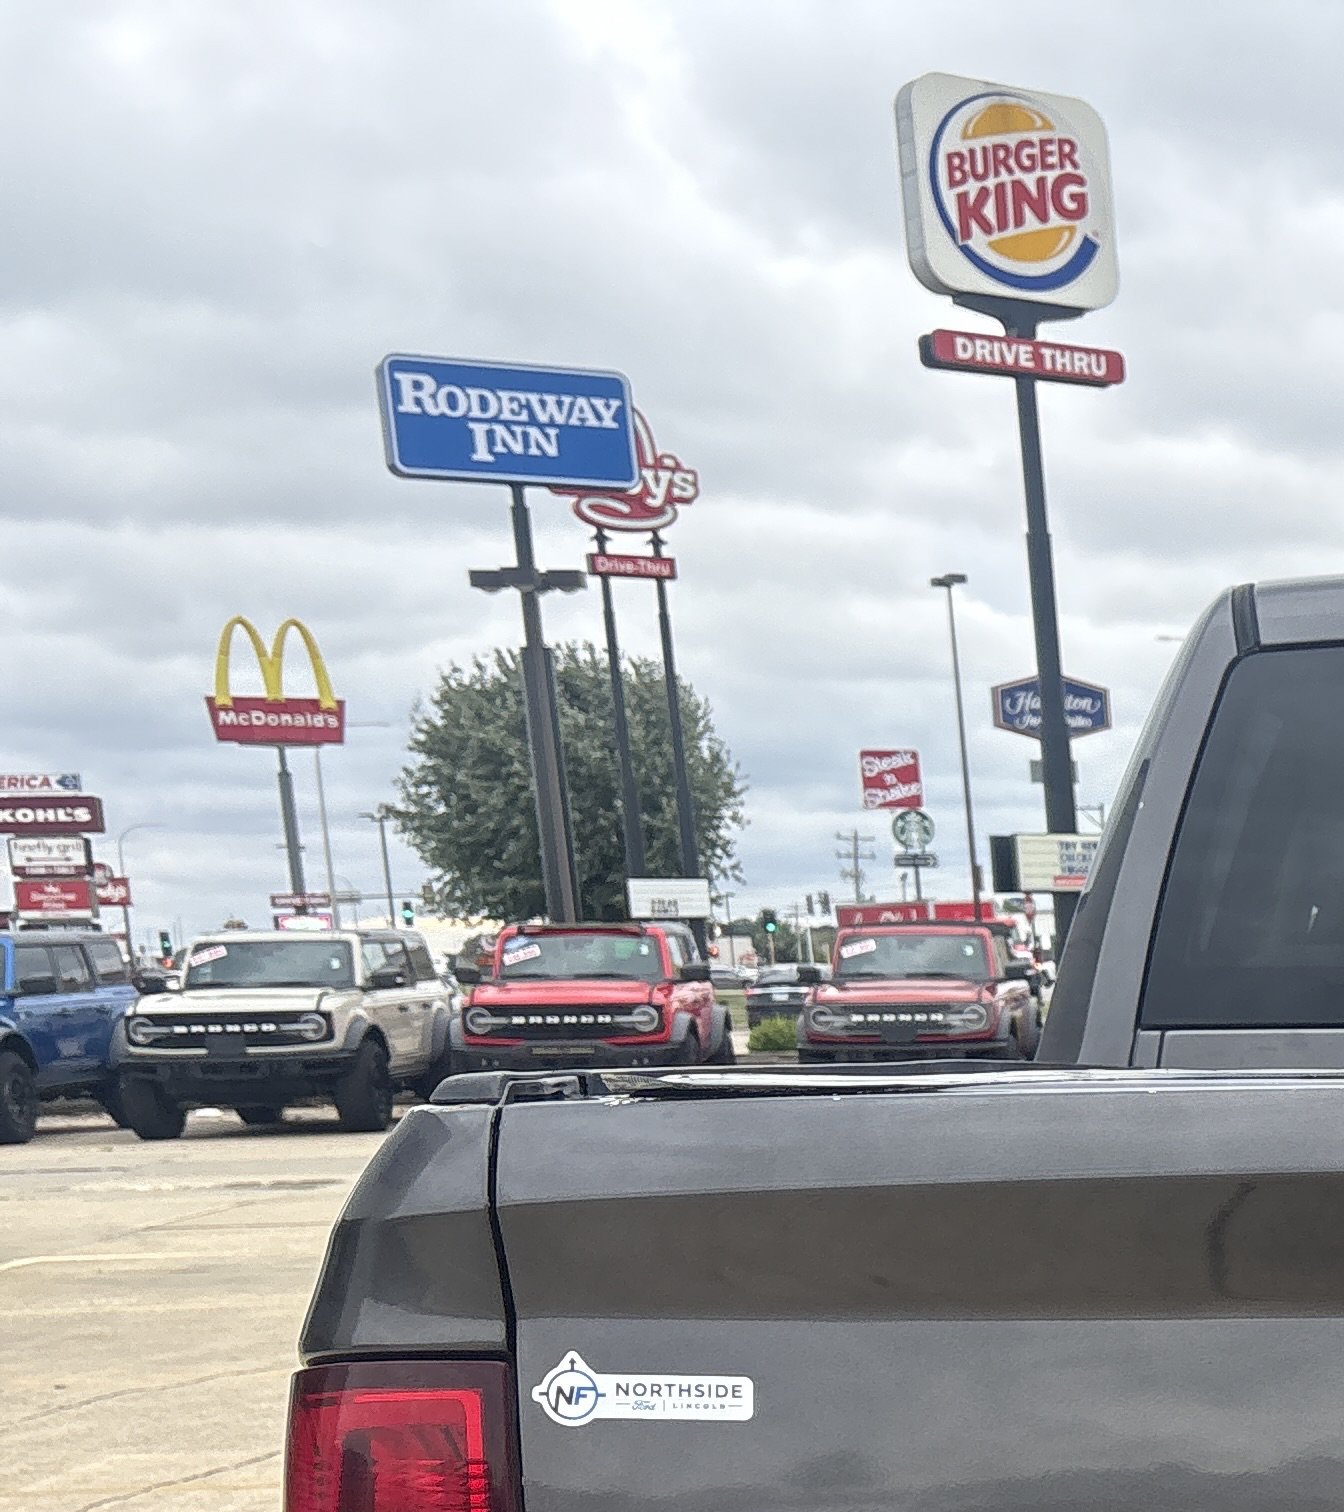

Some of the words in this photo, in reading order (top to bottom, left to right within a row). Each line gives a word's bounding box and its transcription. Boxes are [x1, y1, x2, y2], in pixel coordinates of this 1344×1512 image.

[946, 137, 1080, 188] BURGER
[957, 172, 1088, 242] KING
[954, 336, 1035, 368] DRIVE
[1039, 348, 1107, 377] THRU
[394, 372, 622, 429] RODEWAY
[467, 421, 560, 463] INN
[218, 710, 339, 728] McDonald's
[0, 806, 92, 823] KOHL'S
[615, 1382, 743, 1399] NORTHSIDE
